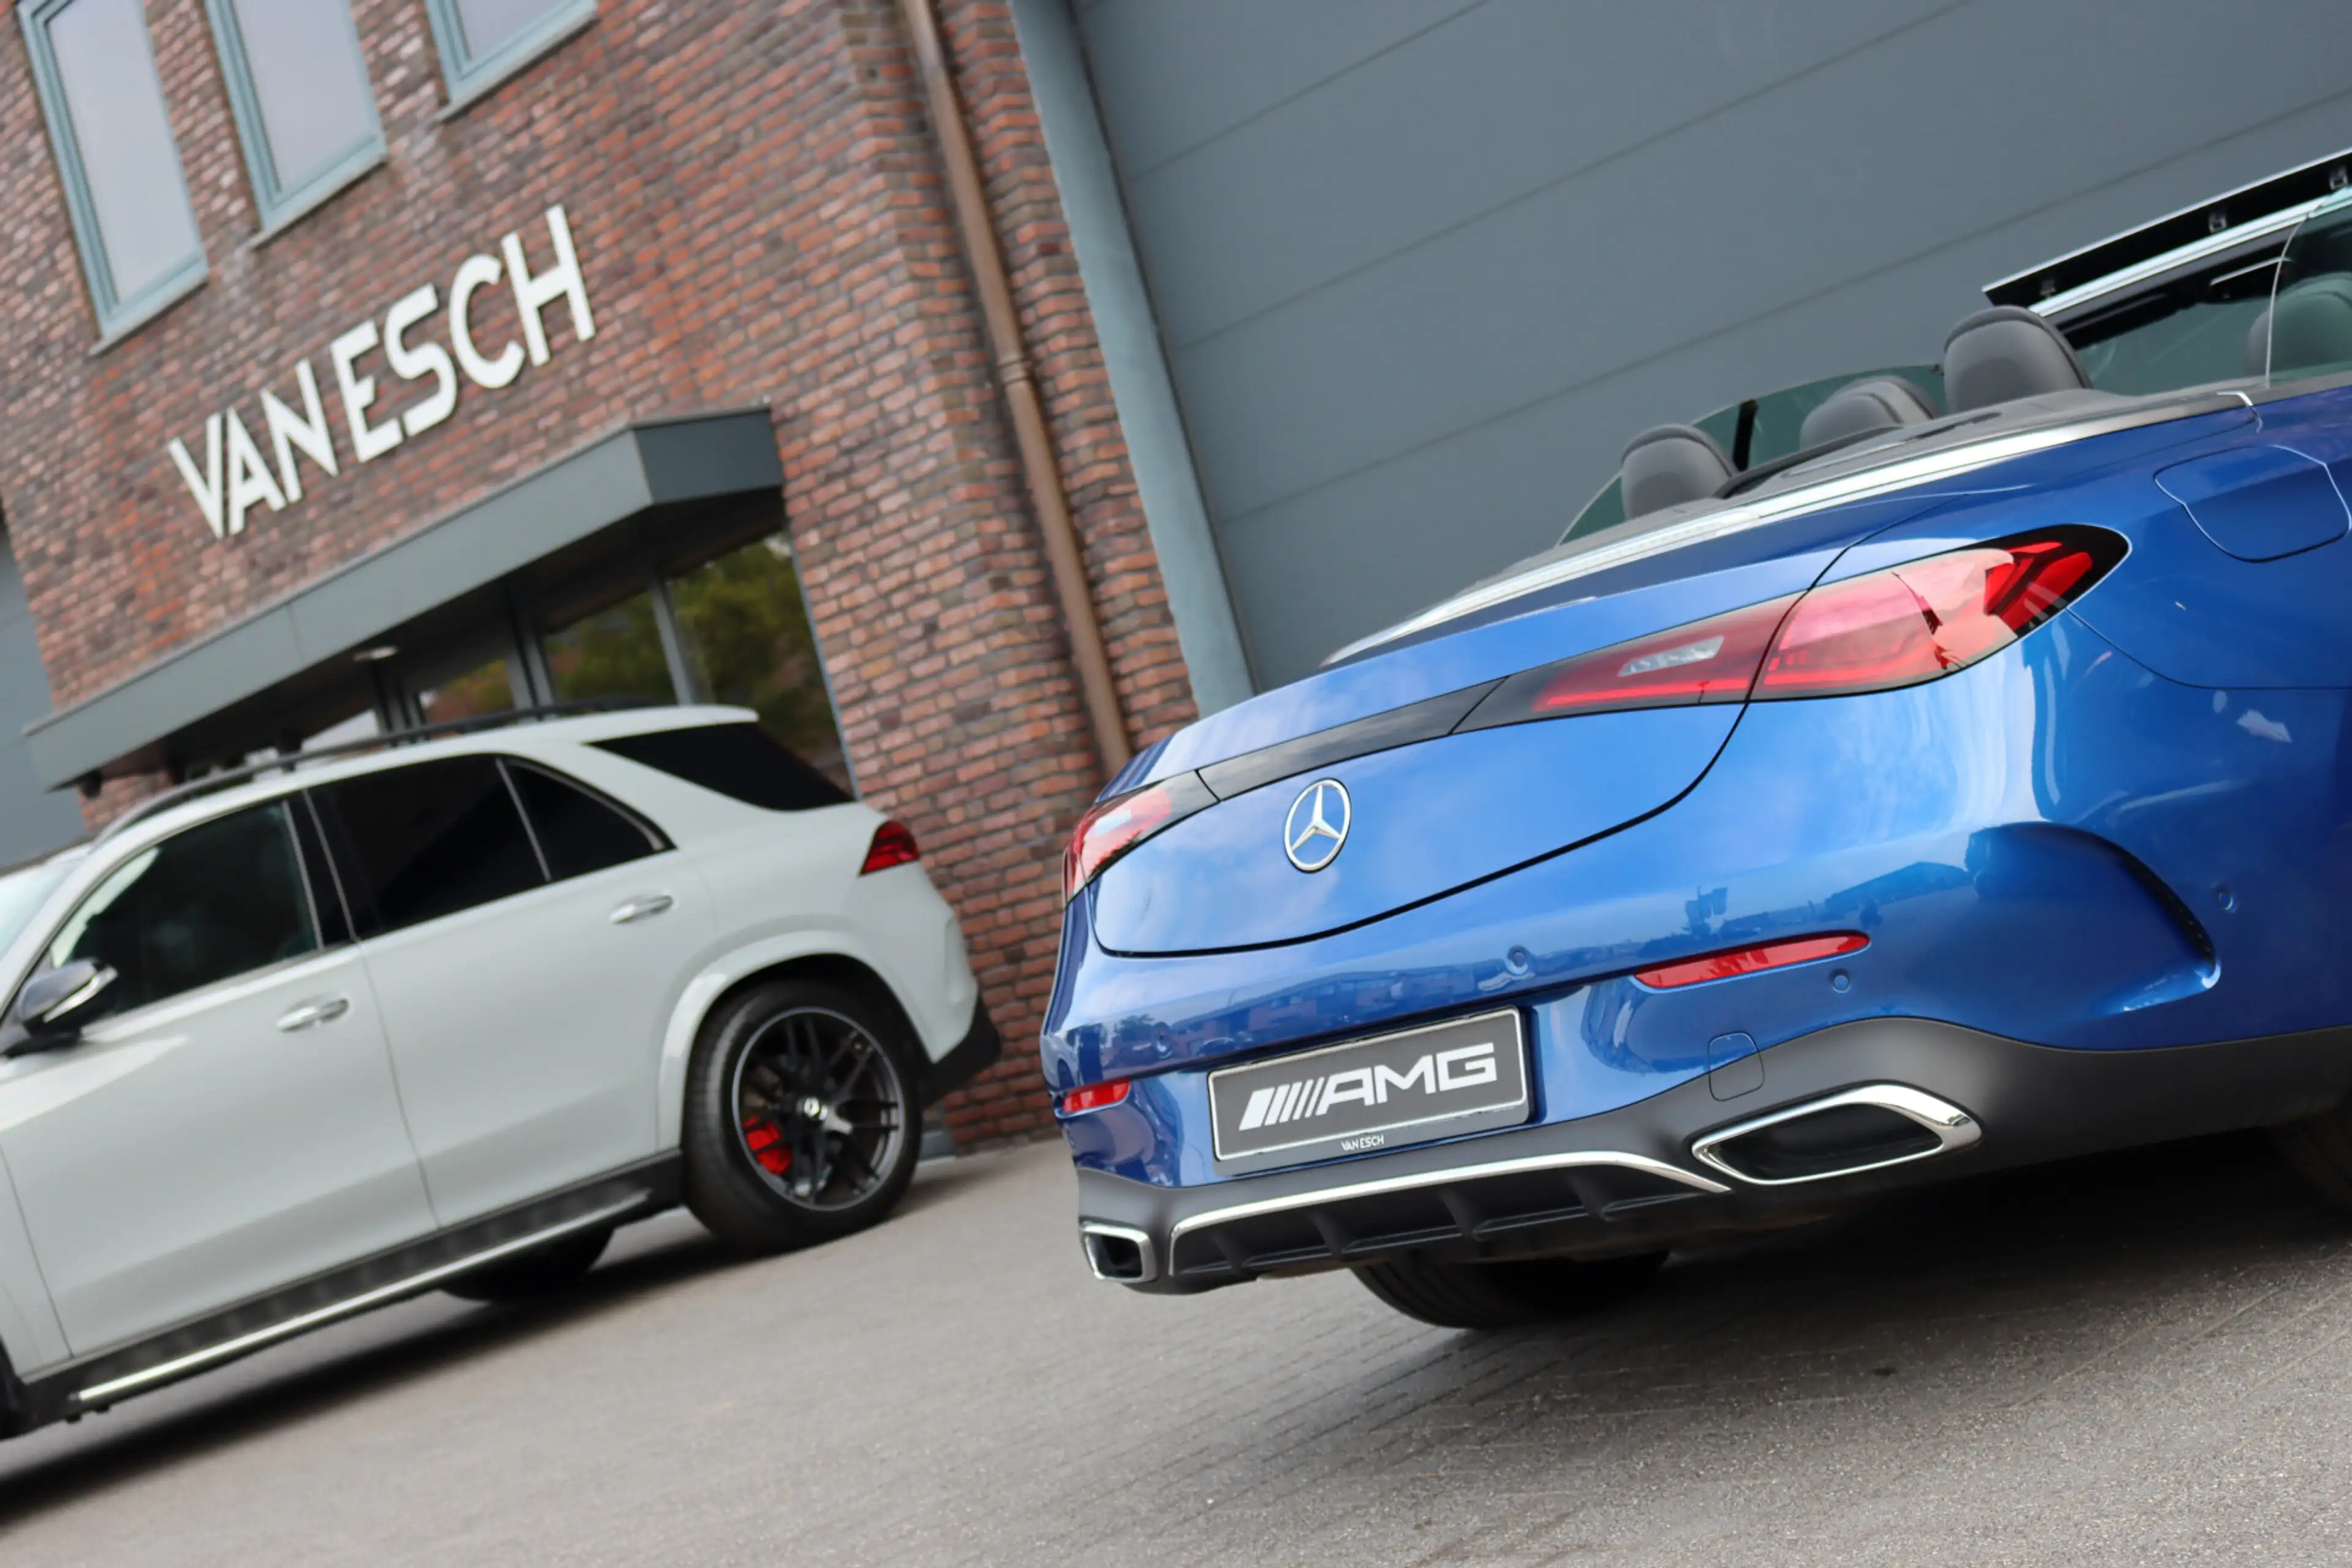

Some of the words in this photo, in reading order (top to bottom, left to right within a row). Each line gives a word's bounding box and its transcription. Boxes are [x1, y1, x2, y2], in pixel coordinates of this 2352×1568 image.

[168, 358, 338, 540] VAN
[330, 204, 595, 463] ESCH
[1317, 1042, 1498, 1117] AMG
